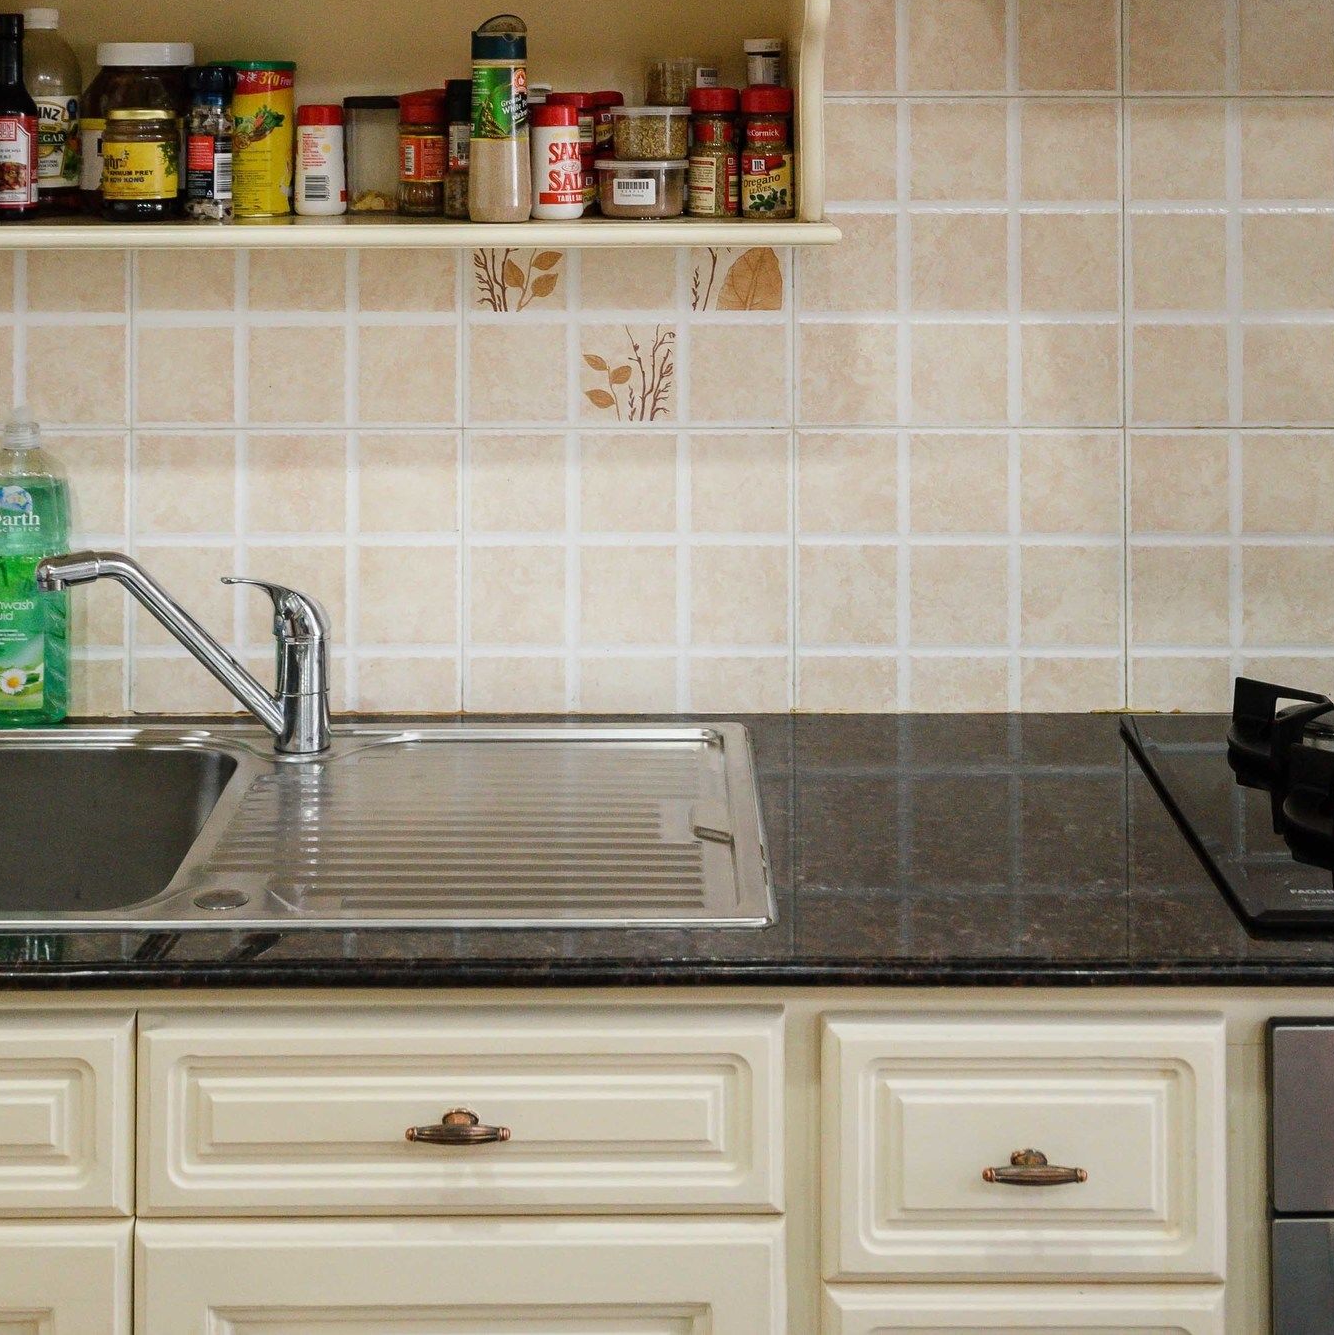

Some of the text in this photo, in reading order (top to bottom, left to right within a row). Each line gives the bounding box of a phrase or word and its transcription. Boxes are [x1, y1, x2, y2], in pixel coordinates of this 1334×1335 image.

[37, 106, 61, 121] INZ
[549, 142, 581, 164] SAX
[549, 169, 581, 191] SAL
[744, 174, 781, 190] Oregano
